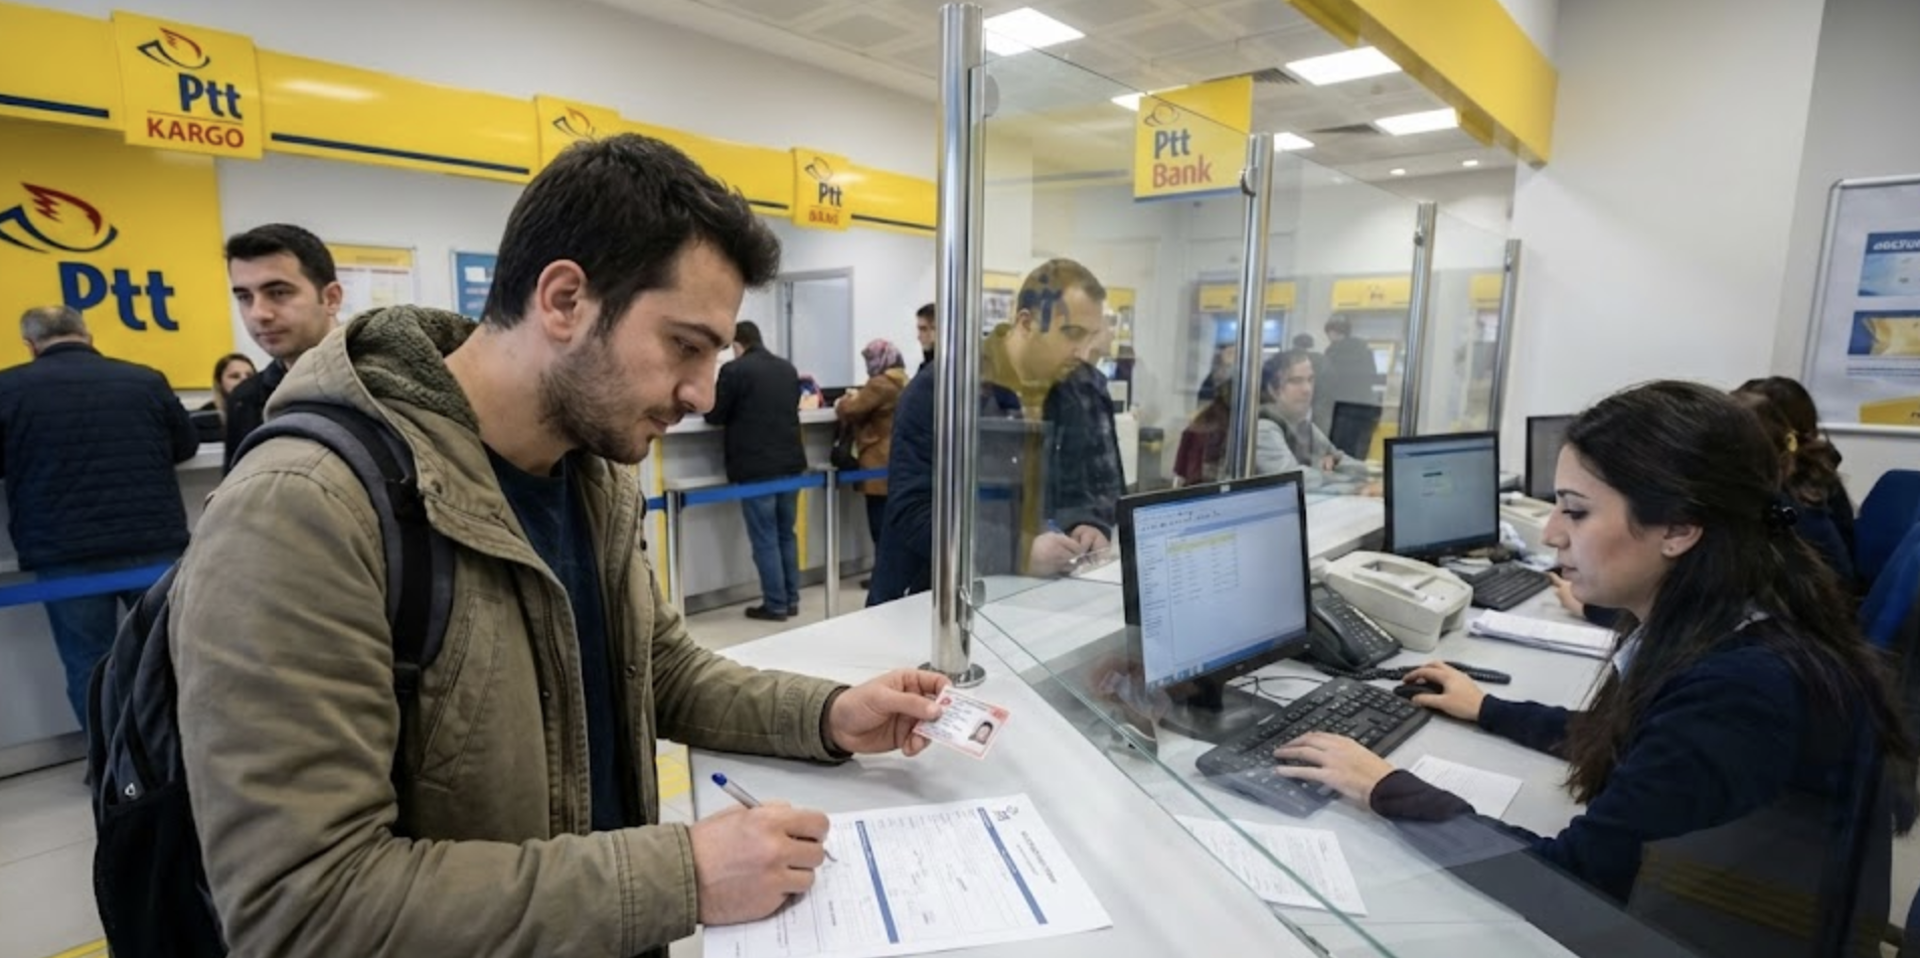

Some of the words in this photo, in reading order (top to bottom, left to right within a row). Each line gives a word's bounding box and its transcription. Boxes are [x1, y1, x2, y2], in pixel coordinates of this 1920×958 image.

[178, 72, 243, 119] Ptt
[147, 117, 244, 148] KARGO
[1154, 128, 1191, 159] Ptt
[1153, 155, 1212, 188] Bank
[819, 182, 842, 208] Ptt
[58, 261, 179, 331] Ptt
